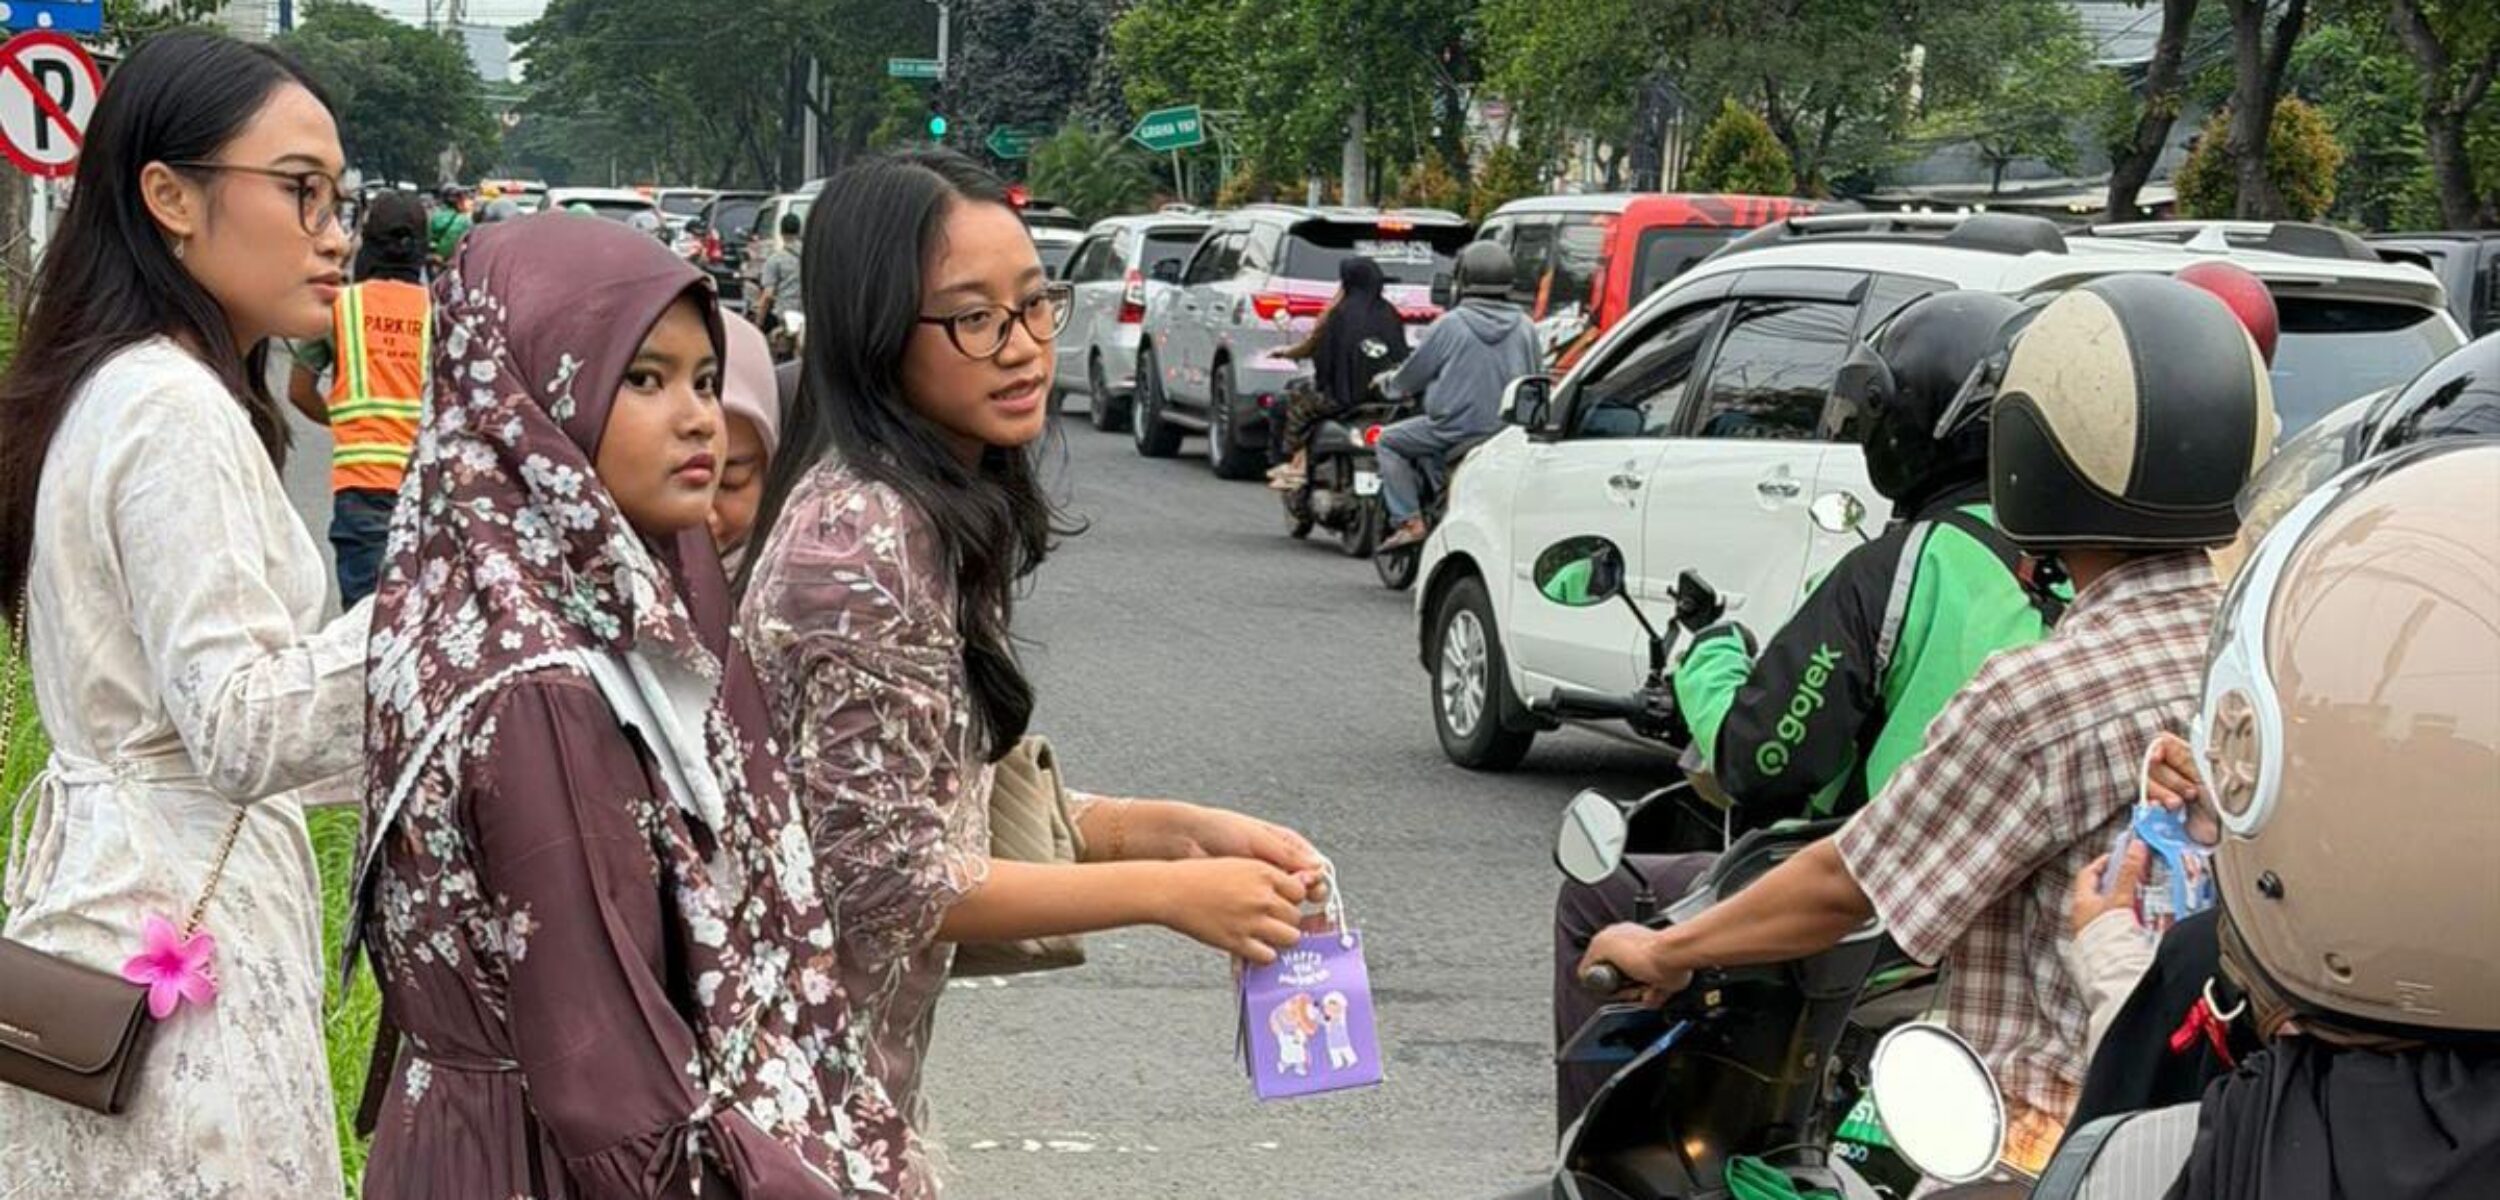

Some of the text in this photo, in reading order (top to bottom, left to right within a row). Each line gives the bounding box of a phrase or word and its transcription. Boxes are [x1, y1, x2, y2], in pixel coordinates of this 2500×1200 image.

[32, 59, 74, 150] P
[364, 315, 424, 337] PARKIR
[1777, 642, 1842, 745] gojek
